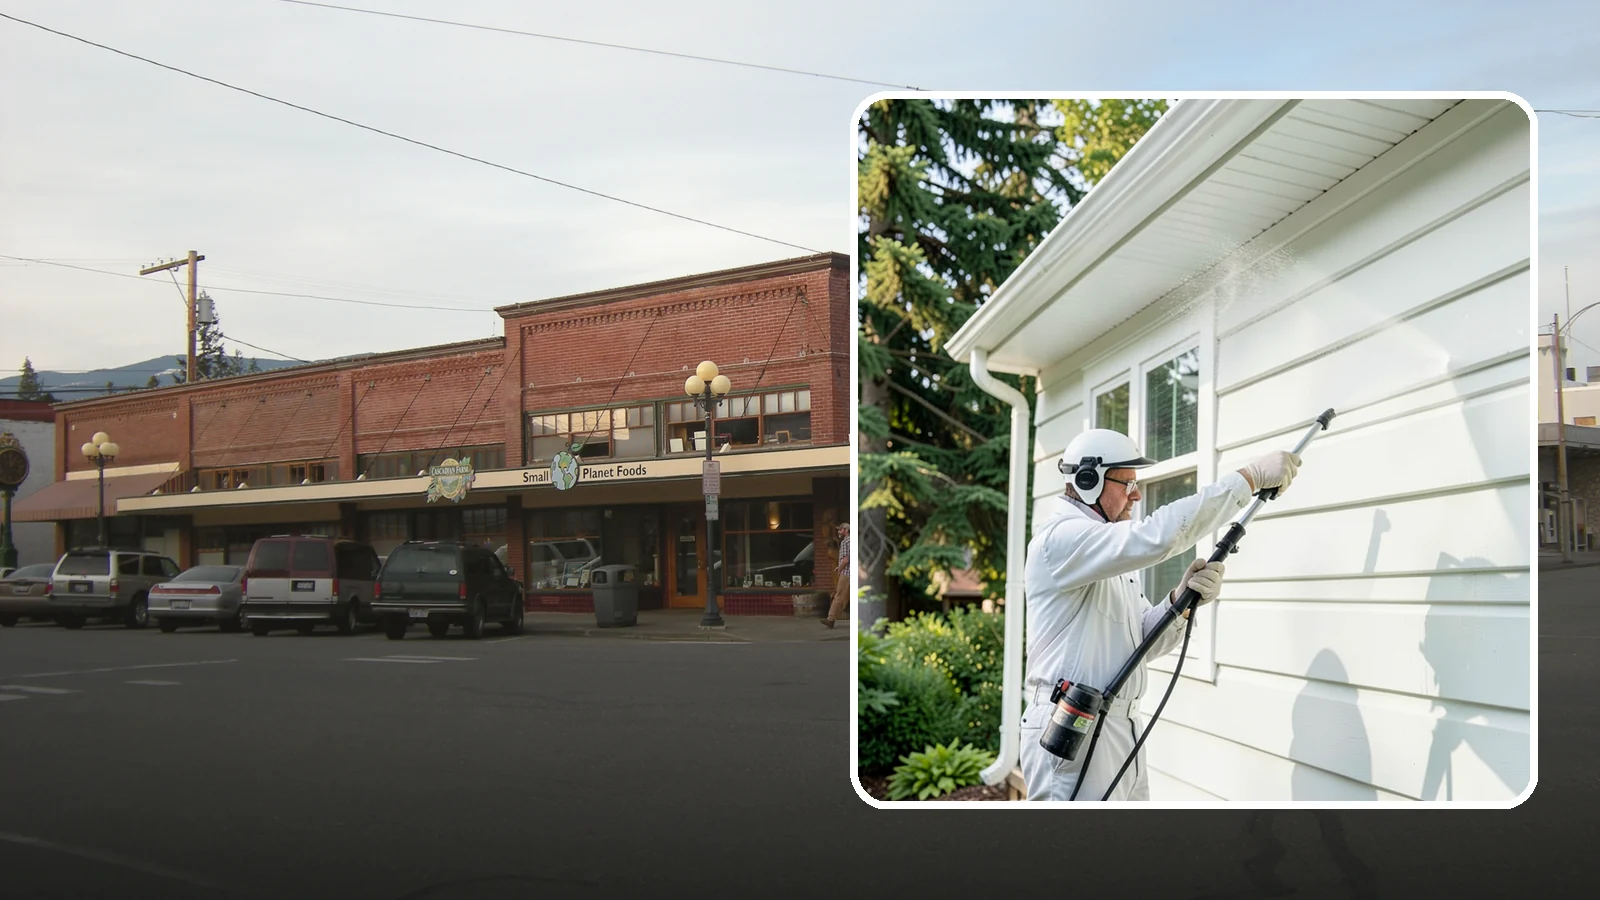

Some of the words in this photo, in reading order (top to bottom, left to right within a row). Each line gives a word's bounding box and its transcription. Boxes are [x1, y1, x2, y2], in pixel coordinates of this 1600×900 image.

[523, 471, 549, 483] Small
[583, 468, 614, 480] Planet
[617, 464, 647, 477] Foods
